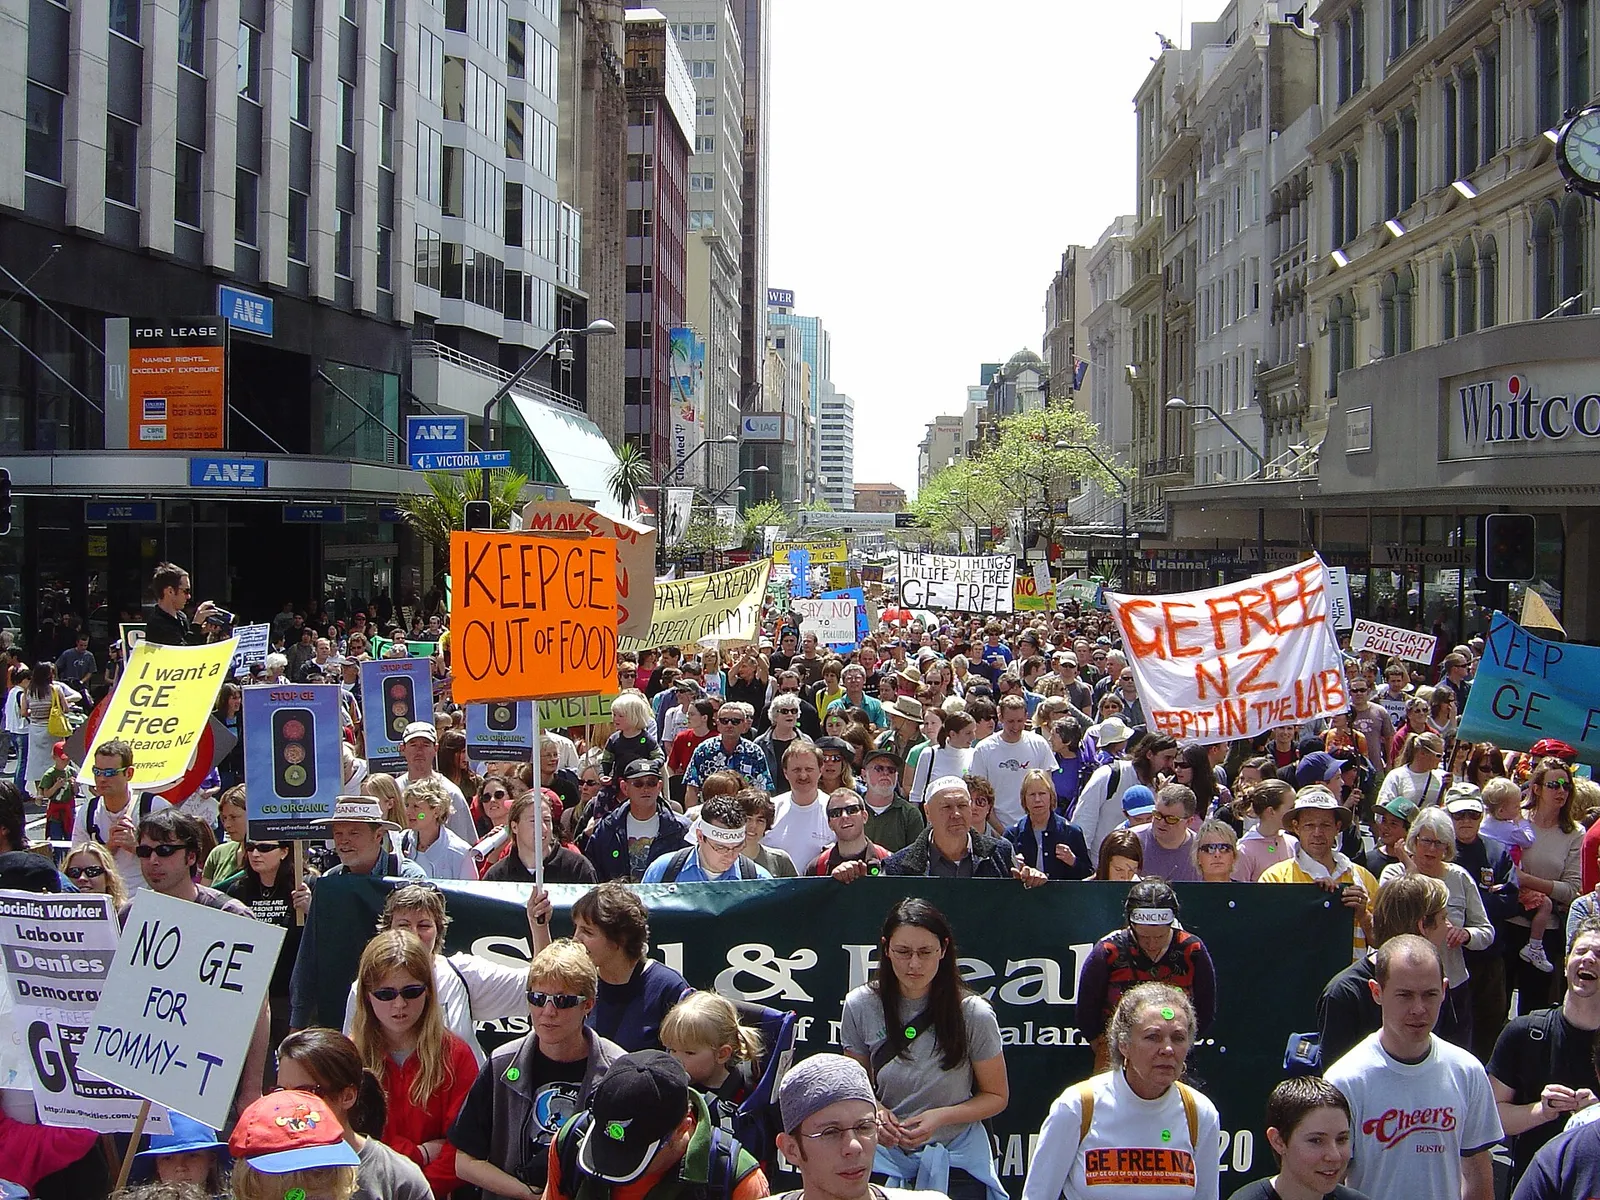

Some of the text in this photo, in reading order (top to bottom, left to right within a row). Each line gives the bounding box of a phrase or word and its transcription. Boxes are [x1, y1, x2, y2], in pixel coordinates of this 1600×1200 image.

[767, 290, 792, 303] WER
[233, 297, 264, 325] ANZ
[136, 327, 217, 338] FOR LEASE
[178, 366, 220, 374] EXPOSURE
[1459, 374, 1600, 444] Whitco
[415, 425, 457, 440] ANZ
[760, 423, 777, 432] IAG
[436, 454, 480, 468] VICTORIA
[203, 463, 255, 482] ANZ
[107, 507, 132, 517] ANZ
[302, 510, 323, 518] ANZ
[904, 553, 926, 566] THE
[934, 556, 961, 569] BEST
[963, 555, 1012, 570] THINGS
[1388, 549, 1472, 563] Whitcoulls
[464, 540, 560, 612] KEEP
[564, 547, 615, 610] G.E.
[903, 566, 1010, 584] IN LIFE ARE FREE
[654, 581, 693, 610] HAVE
[700, 566, 762, 603] ALREADY
[1016, 578, 1037, 596] NO
[956, 584, 1006, 613] FREE
[800, 602, 852, 618] SAY NO
[1118, 600, 1203, 660] GE
[1204, 563, 1326, 650] FREE
[646, 615, 700, 648] REPEAT
[1356, 622, 1435, 654] BIOSECURITY
[462, 618, 616, 681] OUT OF FOOD
[1487, 620, 1563, 679] KEEP
[140, 662, 220, 682] I want a
[1195, 648, 1280, 700] NZ
[130, 684, 176, 708] GE
[270, 690, 315, 701] STOP GE
[1216, 698, 1247, 738] IN
[1251, 696, 1292, 730] THE
[1294, 670, 1346, 718] LAB
[1492, 684, 1550, 730] GE
[117, 710, 179, 735] Free
[113, 732, 194, 750] tearoa NZ
[490, 734, 526, 743] ORGANIC
[262, 804, 329, 814] GO ORGANIC
[336, 806, 356, 814] GANIC
[46, 904, 102, 918] Worker
[16, 924, 85, 943] Labour
[14, 950, 105, 974] Denies
[130, 920, 254, 992] NO GE
[714, 942, 818, 1002] &
[17, 980, 102, 1002] Democra
[143, 987, 188, 1026] FOR
[94, 1026, 224, 1096] TOMMY-T
[1362, 1106, 1456, 1151] Cheers
[1416, 1144, 1445, 1154] BOSTO
[1086, 1149, 1194, 1174] GE FREE NZ
